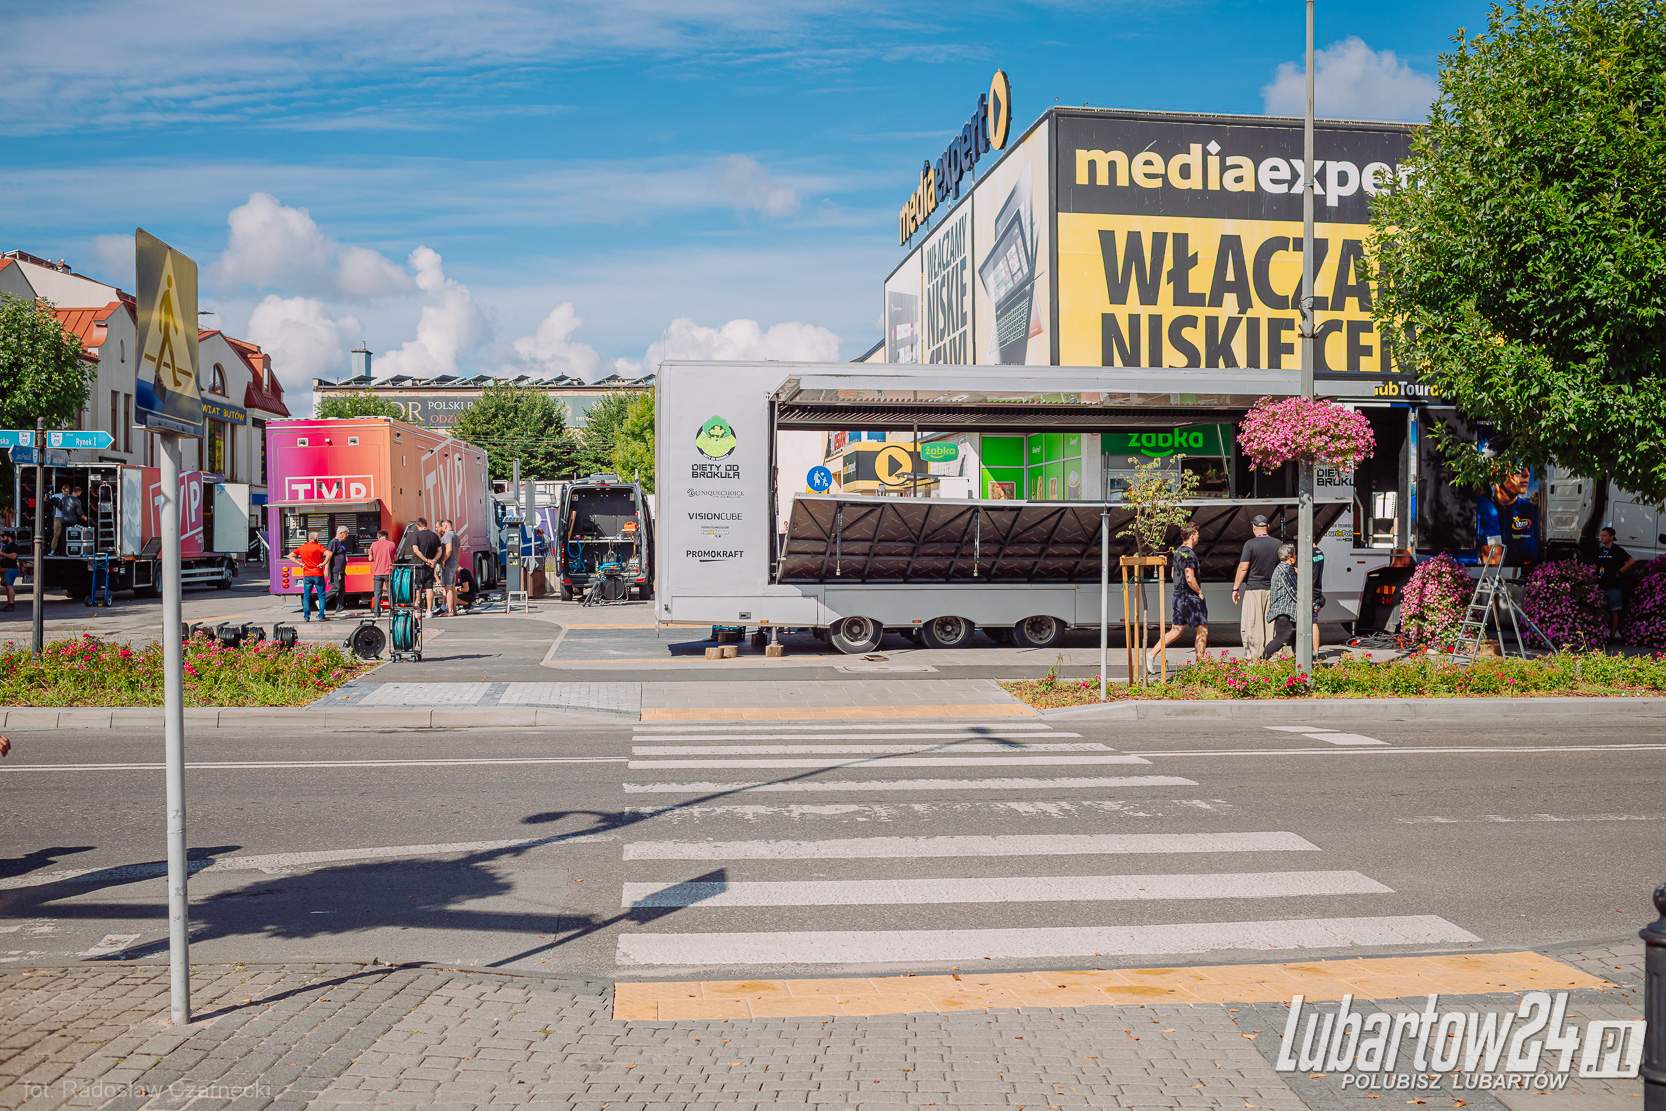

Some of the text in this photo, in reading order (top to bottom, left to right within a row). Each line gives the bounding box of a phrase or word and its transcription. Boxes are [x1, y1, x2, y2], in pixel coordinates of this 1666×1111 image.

[899, 93, 990, 246] mediaexpert
[1075, 139, 1419, 207] mediaexper
[926, 213, 967, 286] WŁĄCZAMY
[1098, 229, 1401, 316] WŁĄCZA
[927, 256, 967, 351] NISKIE
[1101, 313, 1295, 370] NISKIE
[201, 402, 220, 416] WIAT
[428, 402, 464, 410] POLSKI
[75, 437, 92, 447] Rynek
[691, 463, 722, 471] DIETY
[1317, 468, 1342, 478] DIET
[691, 471, 740, 480] BROKUŁA
[291, 482, 368, 500] TVP
[688, 512, 743, 520] VISIONCUBE
[686, 550, 744, 558] PROMOKRAFT
